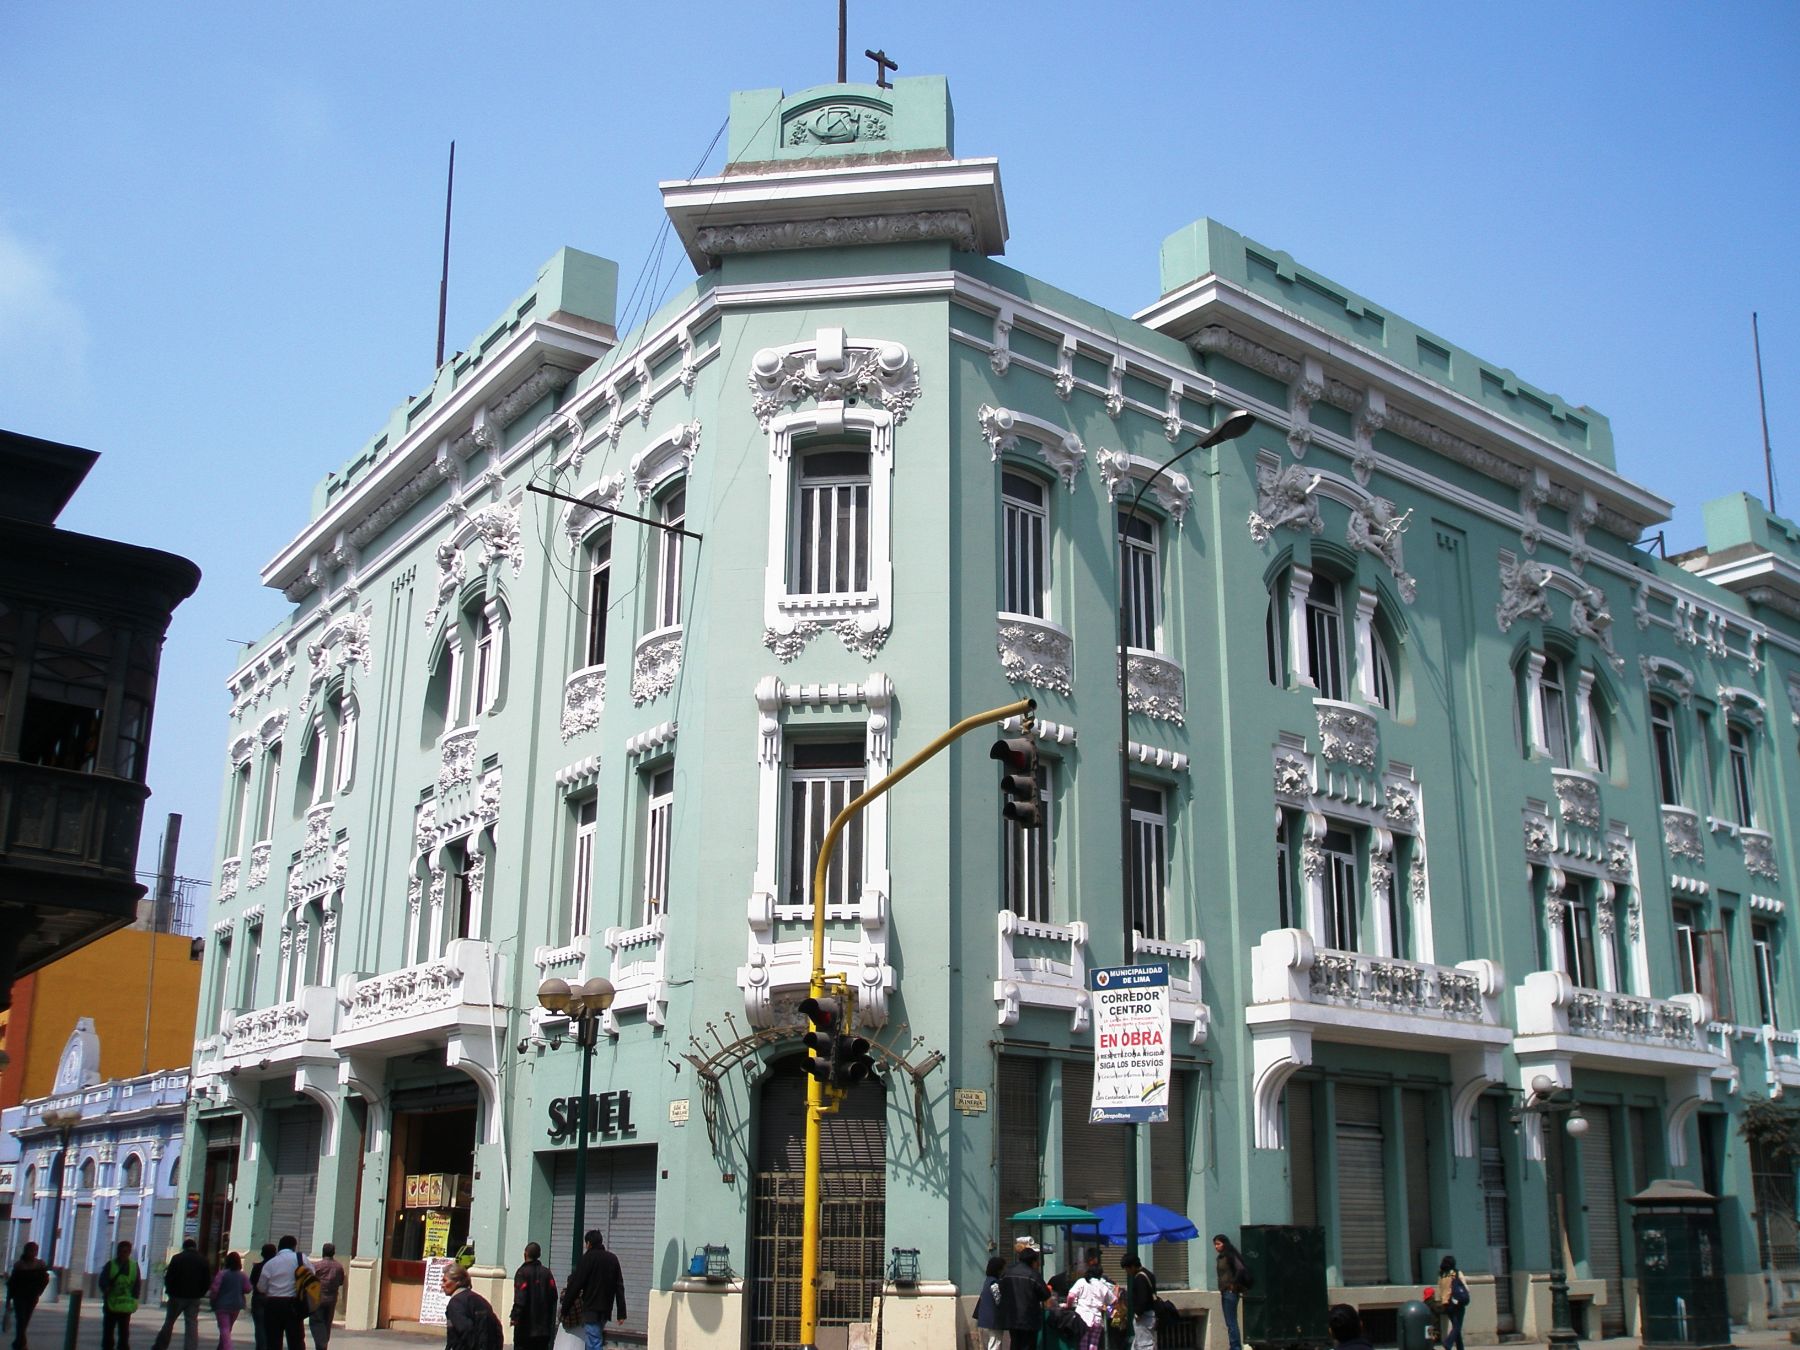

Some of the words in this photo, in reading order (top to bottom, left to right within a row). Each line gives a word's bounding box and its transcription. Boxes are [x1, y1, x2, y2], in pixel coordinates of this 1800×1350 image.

[1110, 967, 1163, 977] MUNICIPALIDAD
[1101, 991, 1160, 1004] CORREDOR
[1109, 1004, 1152, 1015] CENTRO
[1100, 1033, 1118, 1048] EN
[1121, 1030, 1163, 1046] OBRA
[1117, 1060, 1129, 1068] LOS
